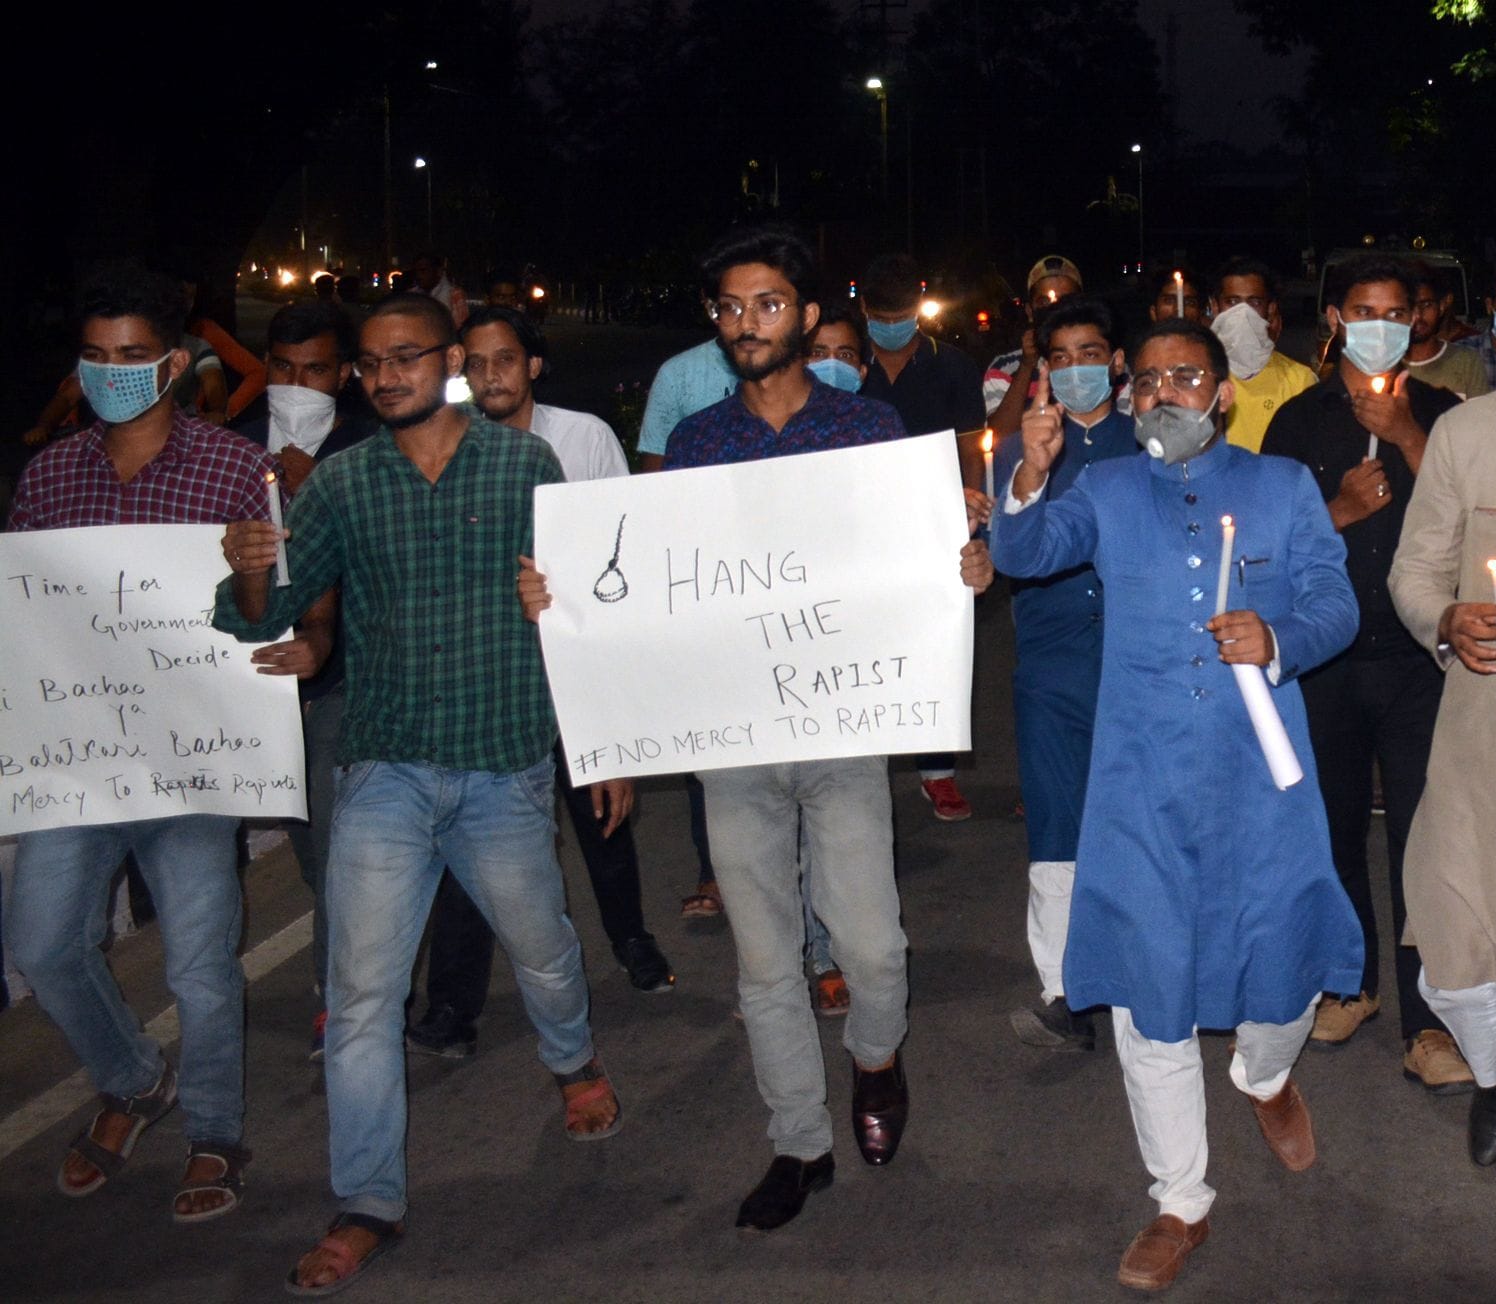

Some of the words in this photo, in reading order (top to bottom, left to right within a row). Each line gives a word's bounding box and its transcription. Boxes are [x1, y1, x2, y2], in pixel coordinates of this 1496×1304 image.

[8, 574, 89, 600] Time
[110, 570, 162, 614] for
[667, 547, 808, 615] HANG
[744, 599, 842, 649] THE
[147, 645, 231, 671] Decide
[39, 675, 146, 702] Bachao
[772, 656, 908, 708] RAPIST
[170, 727, 263, 758] Bachao
[673, 722, 755, 755] MERCY
[774, 714, 821, 740] TO
[837, 701, 941, 736] RAPIST
[12, 784, 86, 816] Mercy
[105, 774, 131, 800] To
